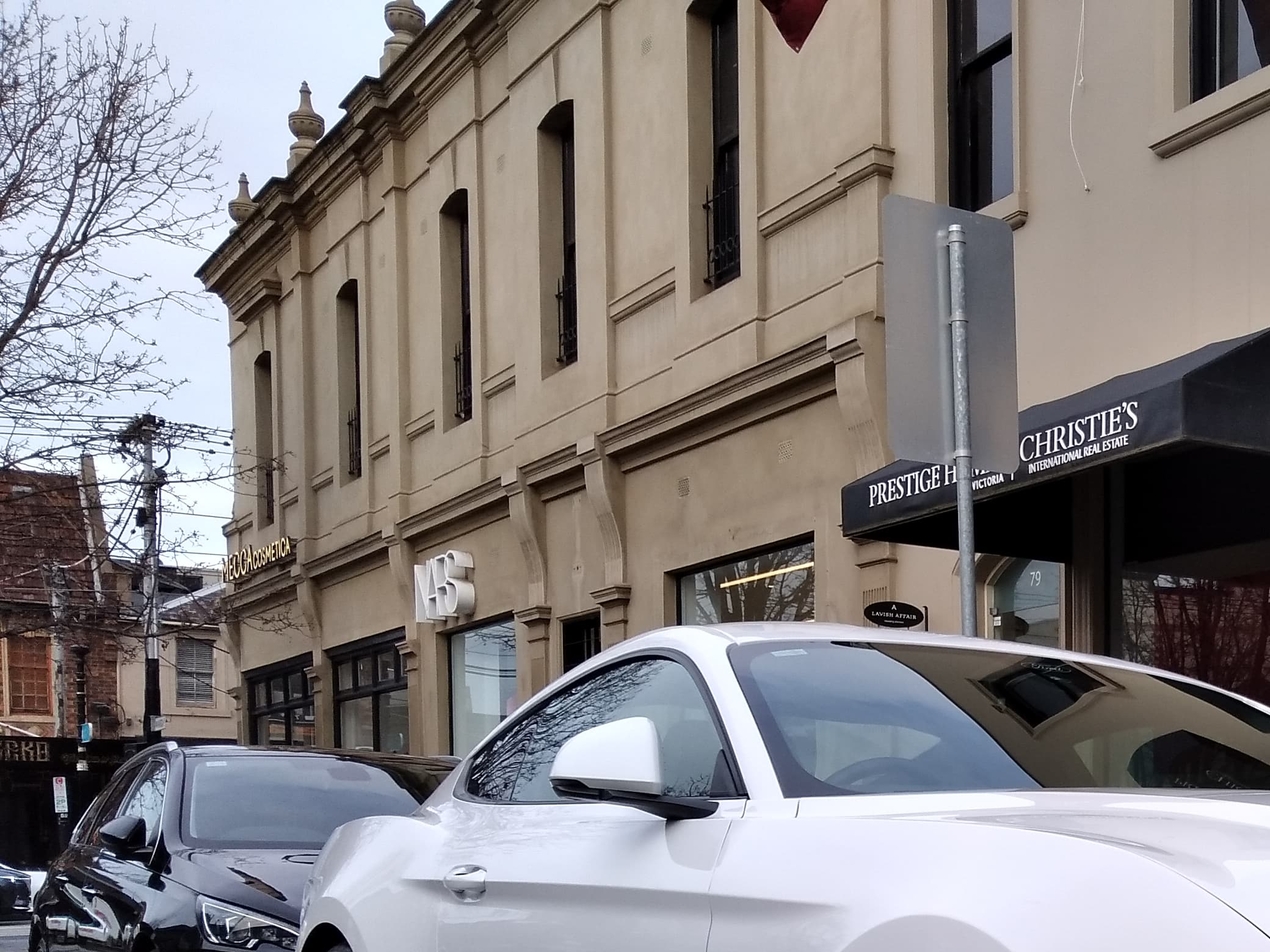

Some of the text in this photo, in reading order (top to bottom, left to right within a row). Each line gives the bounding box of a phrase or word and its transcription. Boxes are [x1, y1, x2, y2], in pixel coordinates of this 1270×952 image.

[1019, 401, 1139, 462] CHRISTIE'S
[1028, 434, 1129, 474] INTERNATIONAL REAL ESTATE
[868, 464, 941, 508] PRESTIGE
[971, 473, 1005, 491] VICTORIA
[222, 536, 291, 582] MECCA COSMETICA
[1029, 570, 1042, 587] 79
[414, 550, 476, 623] NARS
